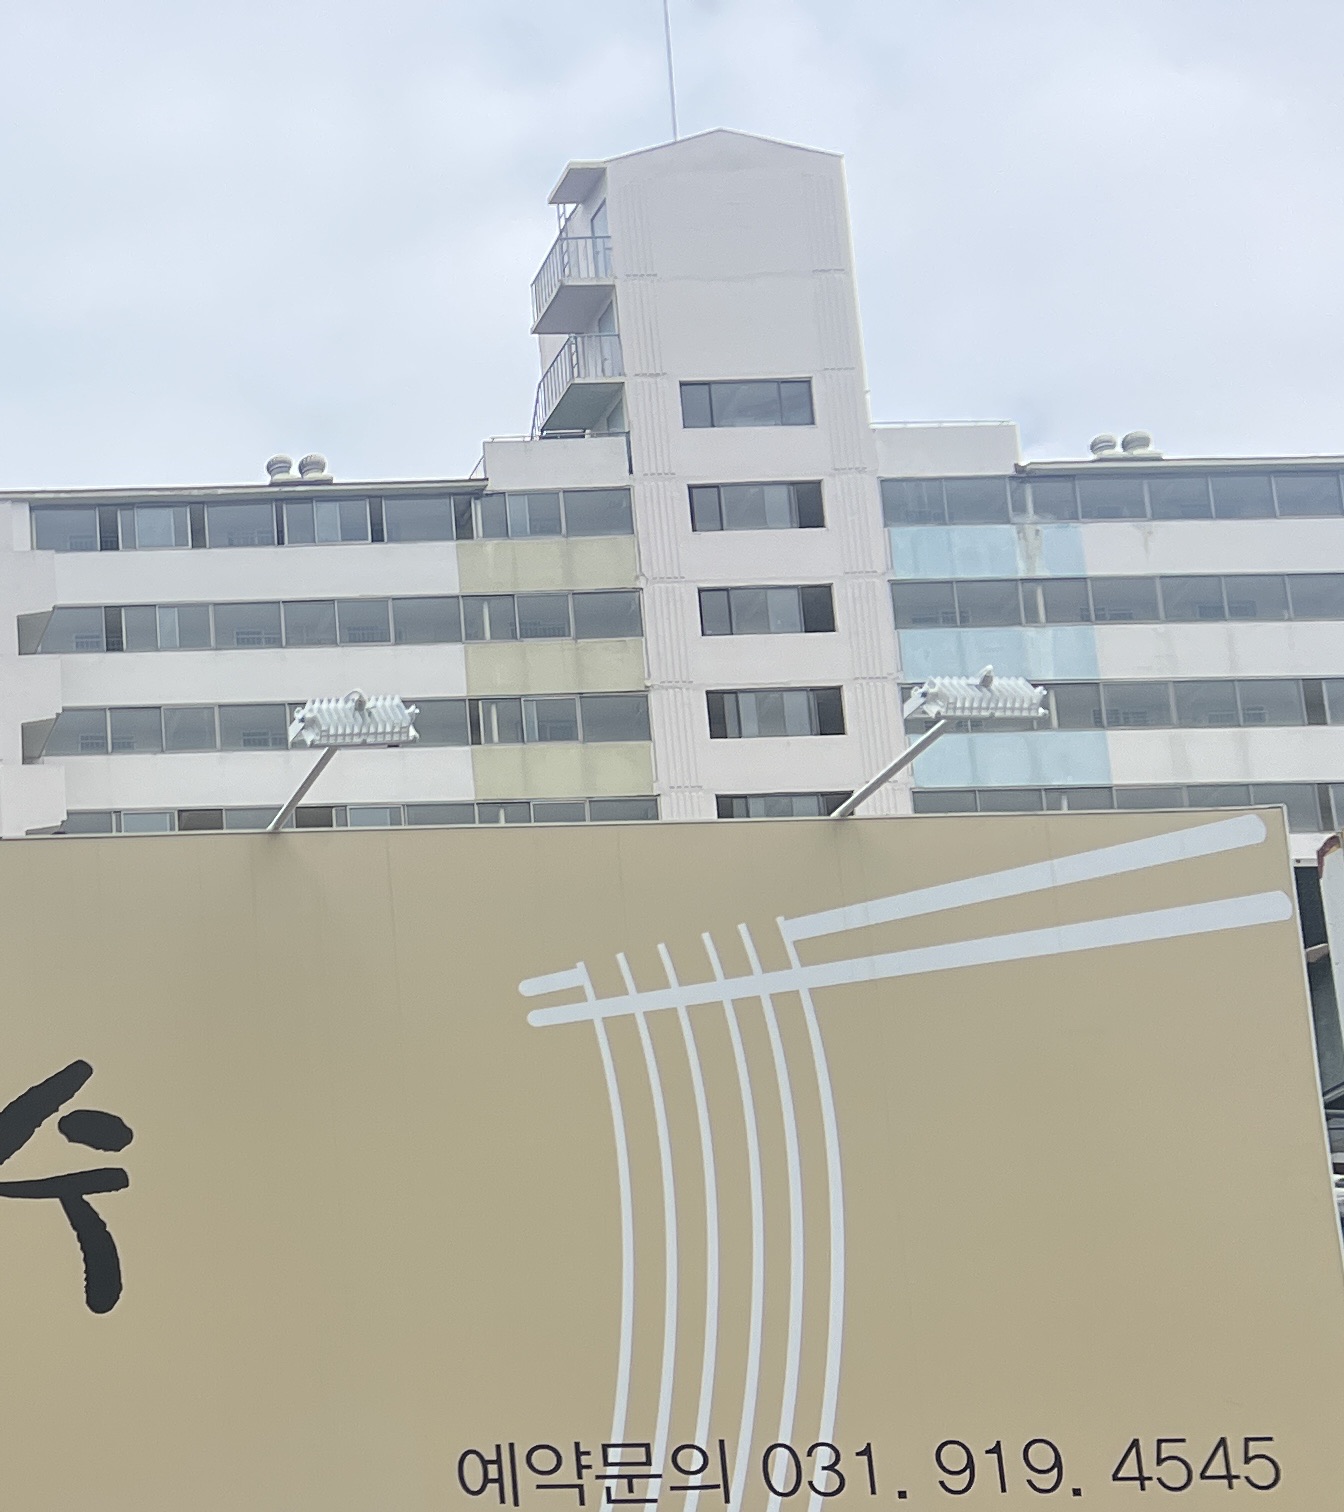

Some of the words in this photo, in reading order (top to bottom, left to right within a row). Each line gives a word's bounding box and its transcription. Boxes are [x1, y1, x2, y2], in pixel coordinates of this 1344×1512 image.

[457, 1440, 731, 1507] 예약문의
[762, 1442, 909, 1500] 031.
[935, 1438, 1083, 1497] 919.
[1111, 1436, 1281, 1492] 4545
